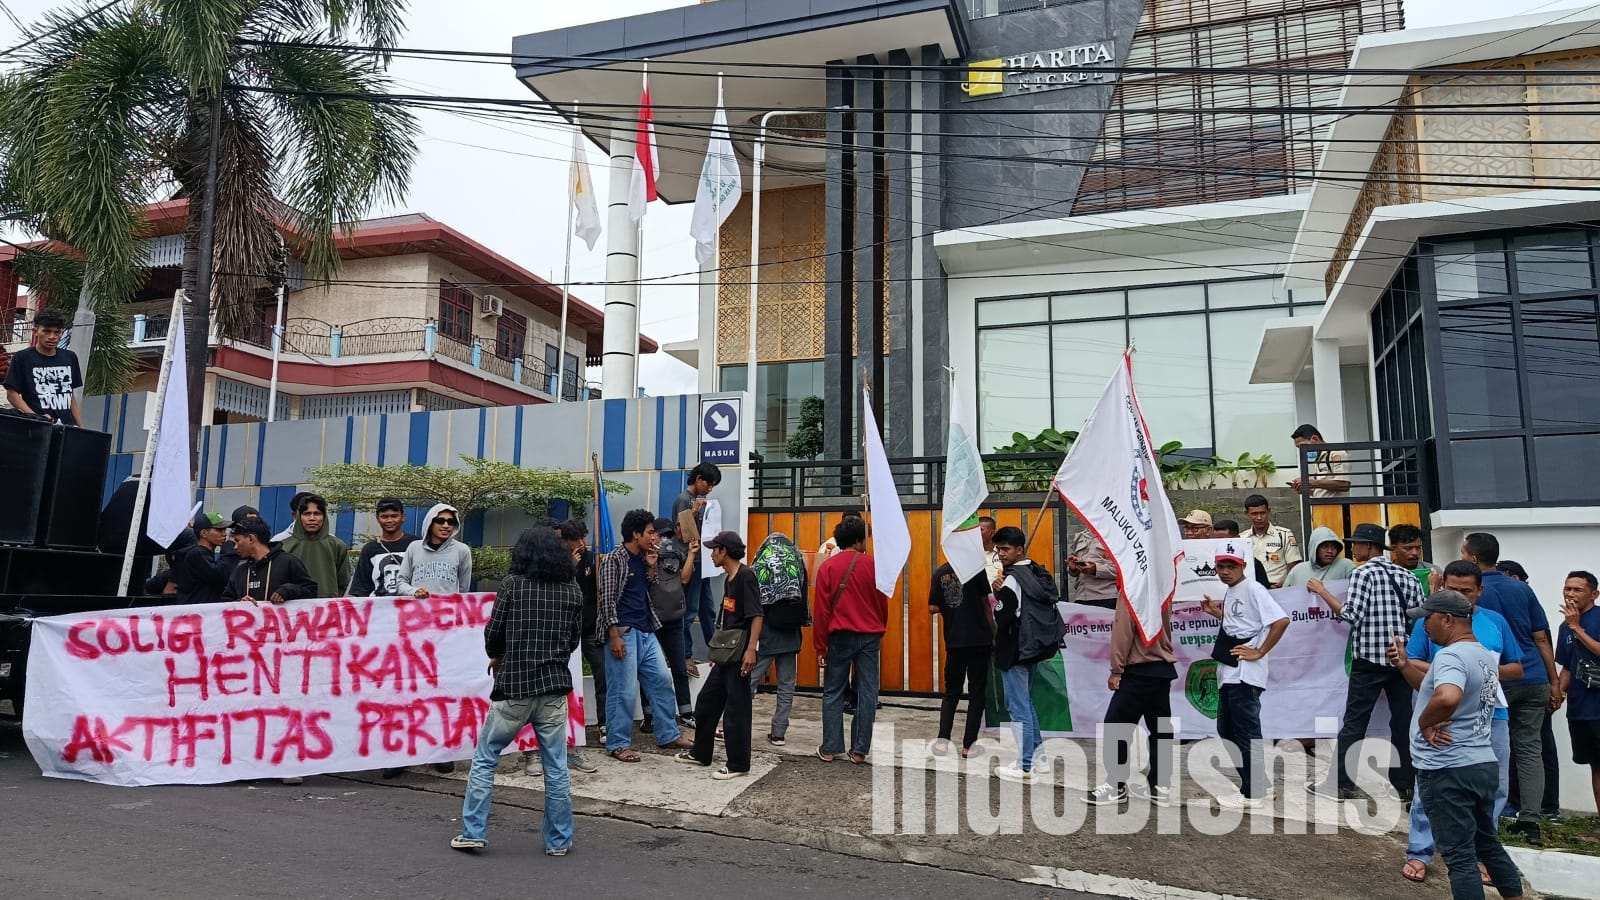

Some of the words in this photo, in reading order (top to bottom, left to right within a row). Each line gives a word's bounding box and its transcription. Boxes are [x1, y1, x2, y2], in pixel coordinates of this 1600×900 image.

[1007, 43, 1114, 76] HARITA
[1018, 71, 1104, 91] NICKEL
[35, 382, 59, 394] OF
[61, 381, 73, 393] A
[704, 449, 735, 457] MASUK
[1101, 495, 1137, 541] MALUKU
[222, 598, 374, 651] RAWAN
[394, 593, 497, 638] BENC
[1291, 610, 1335, 623] Training
[1064, 623, 1088, 635] Solig
[1169, 620, 1186, 632] Pel
[1188, 618, 1221, 631] muda
[1179, 635, 1218, 648] seskan
[164, 638, 439, 708] HENTIKAN
[62, 704, 334, 768] AKTIFITAS
